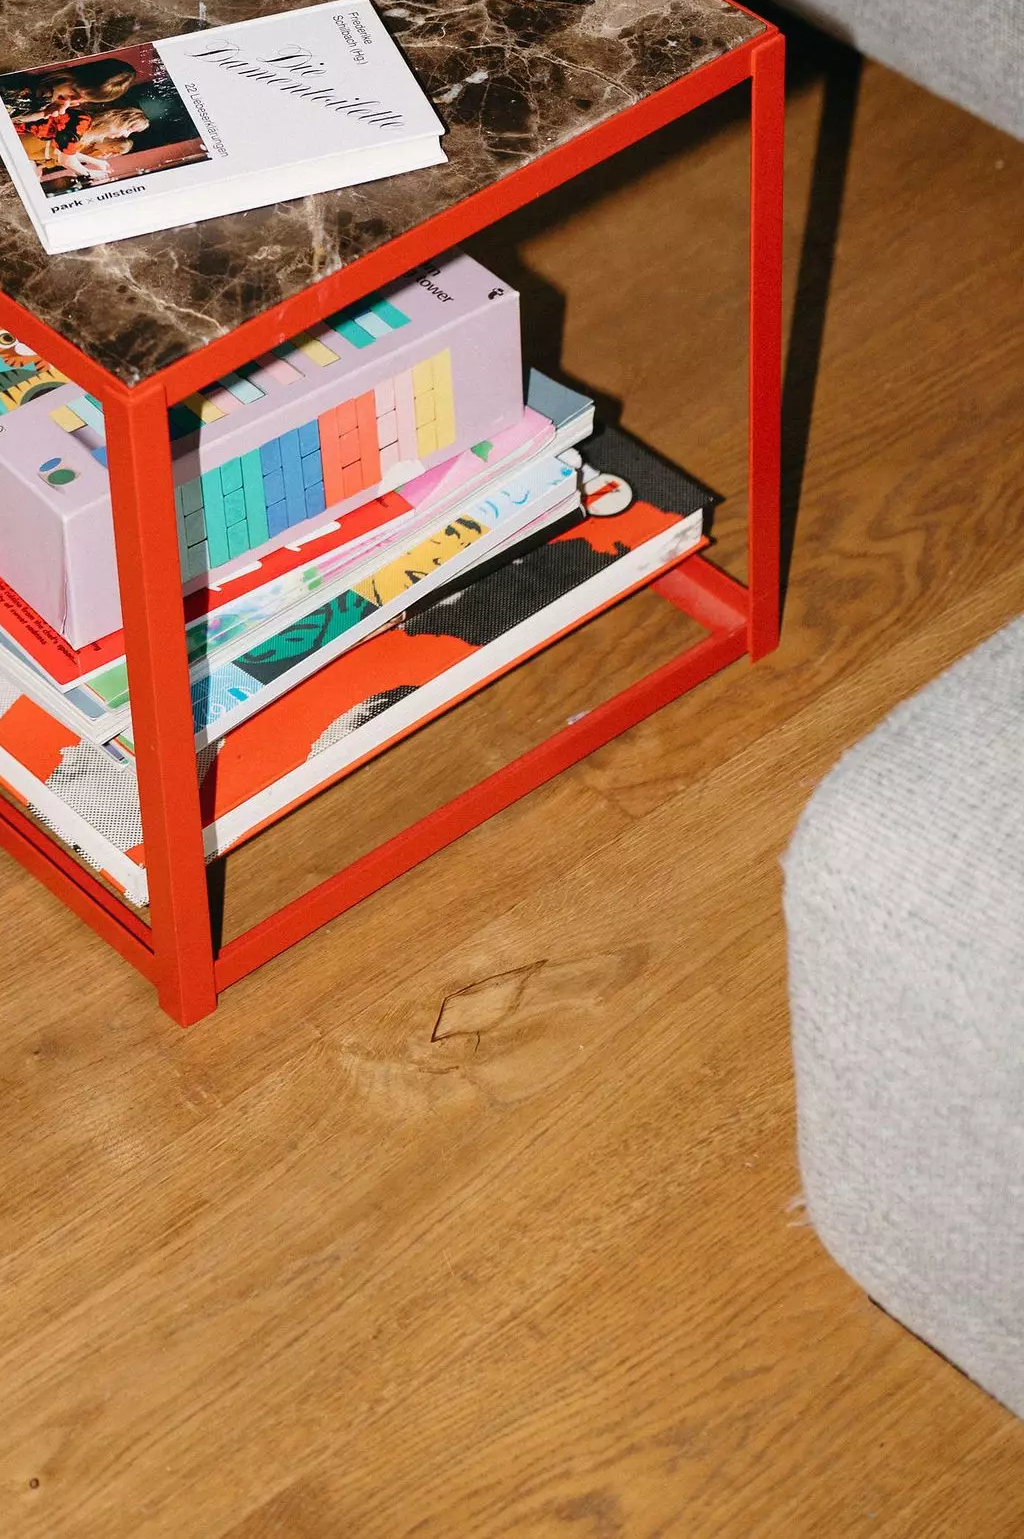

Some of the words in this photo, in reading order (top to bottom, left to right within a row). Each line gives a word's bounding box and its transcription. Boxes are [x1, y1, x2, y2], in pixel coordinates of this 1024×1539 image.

[332, 15, 358, 48] Schilbach
[347, 11, 373, 45] Friederike
[256, 43, 327, 77] Die
[184, 38, 406, 129] Damentoilette
[184, 83, 198, 98] 22
[190, 94, 229, 158] Liebeserklärungen
[51, 199, 84, 214] park
[96, 184, 147, 202] ullstein
[416, 275, 454, 303] tower
